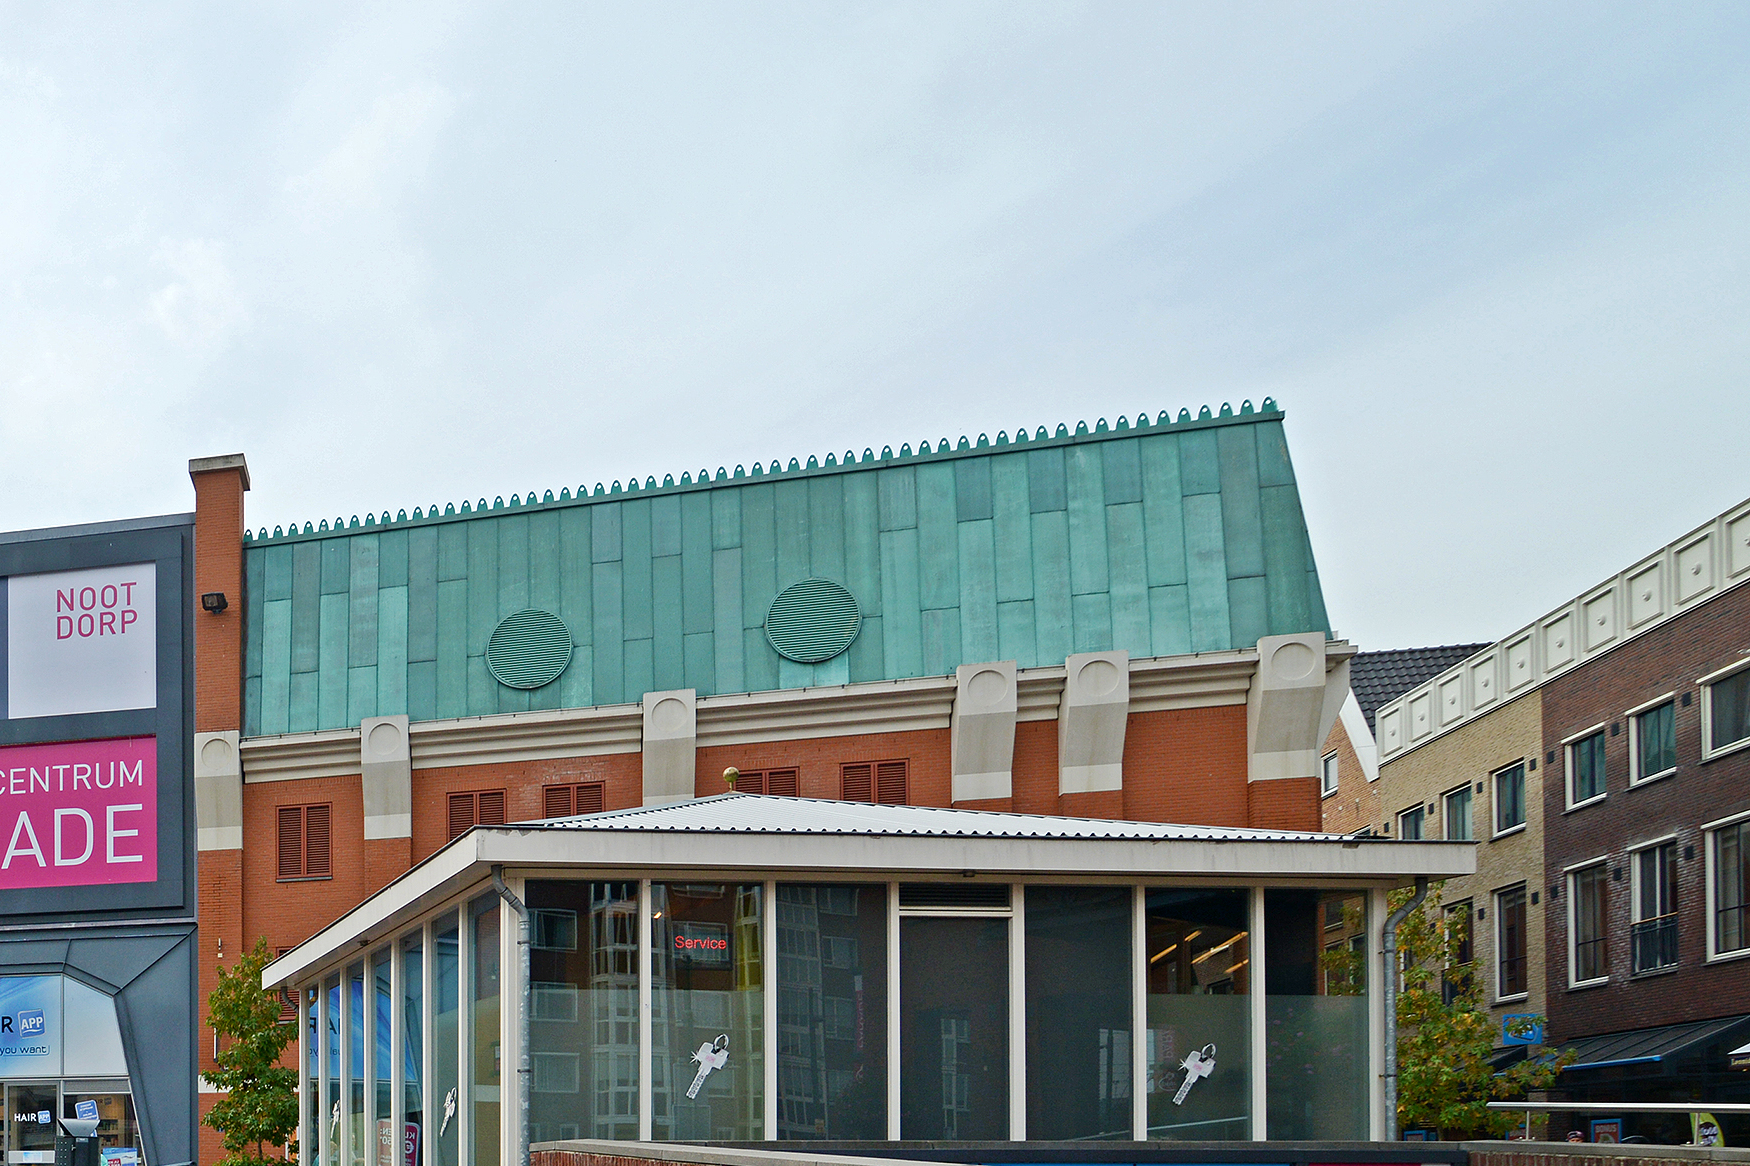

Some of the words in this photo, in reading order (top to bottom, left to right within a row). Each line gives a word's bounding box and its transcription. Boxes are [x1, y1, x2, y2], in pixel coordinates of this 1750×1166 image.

[56, 581, 137, 613] NOOT
[56, 608, 138, 640] DORP
[674, 935, 727, 950] Service
[21, 1016, 44, 1031] APP
[0, 1047, 17, 1056] you
[19, 1046, 47, 1055] want
[14, 1112, 37, 1122] HAIR
